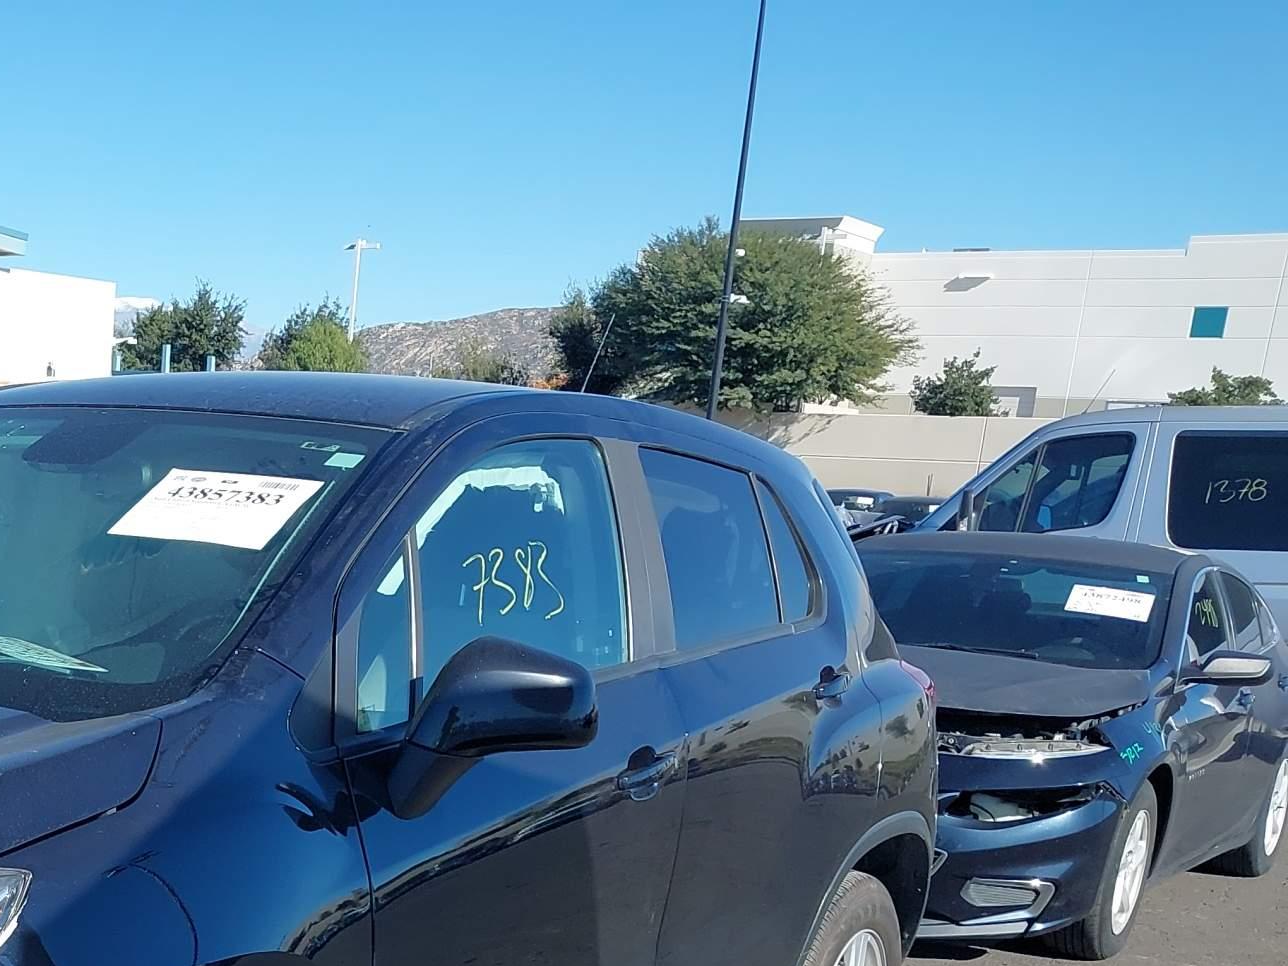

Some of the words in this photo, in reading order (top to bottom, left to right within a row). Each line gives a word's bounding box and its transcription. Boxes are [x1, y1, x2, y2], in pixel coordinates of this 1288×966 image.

[168, 486, 285, 506] 43857383
[1205, 478, 1268, 504] 1378
[462, 541, 564, 626] 7383
